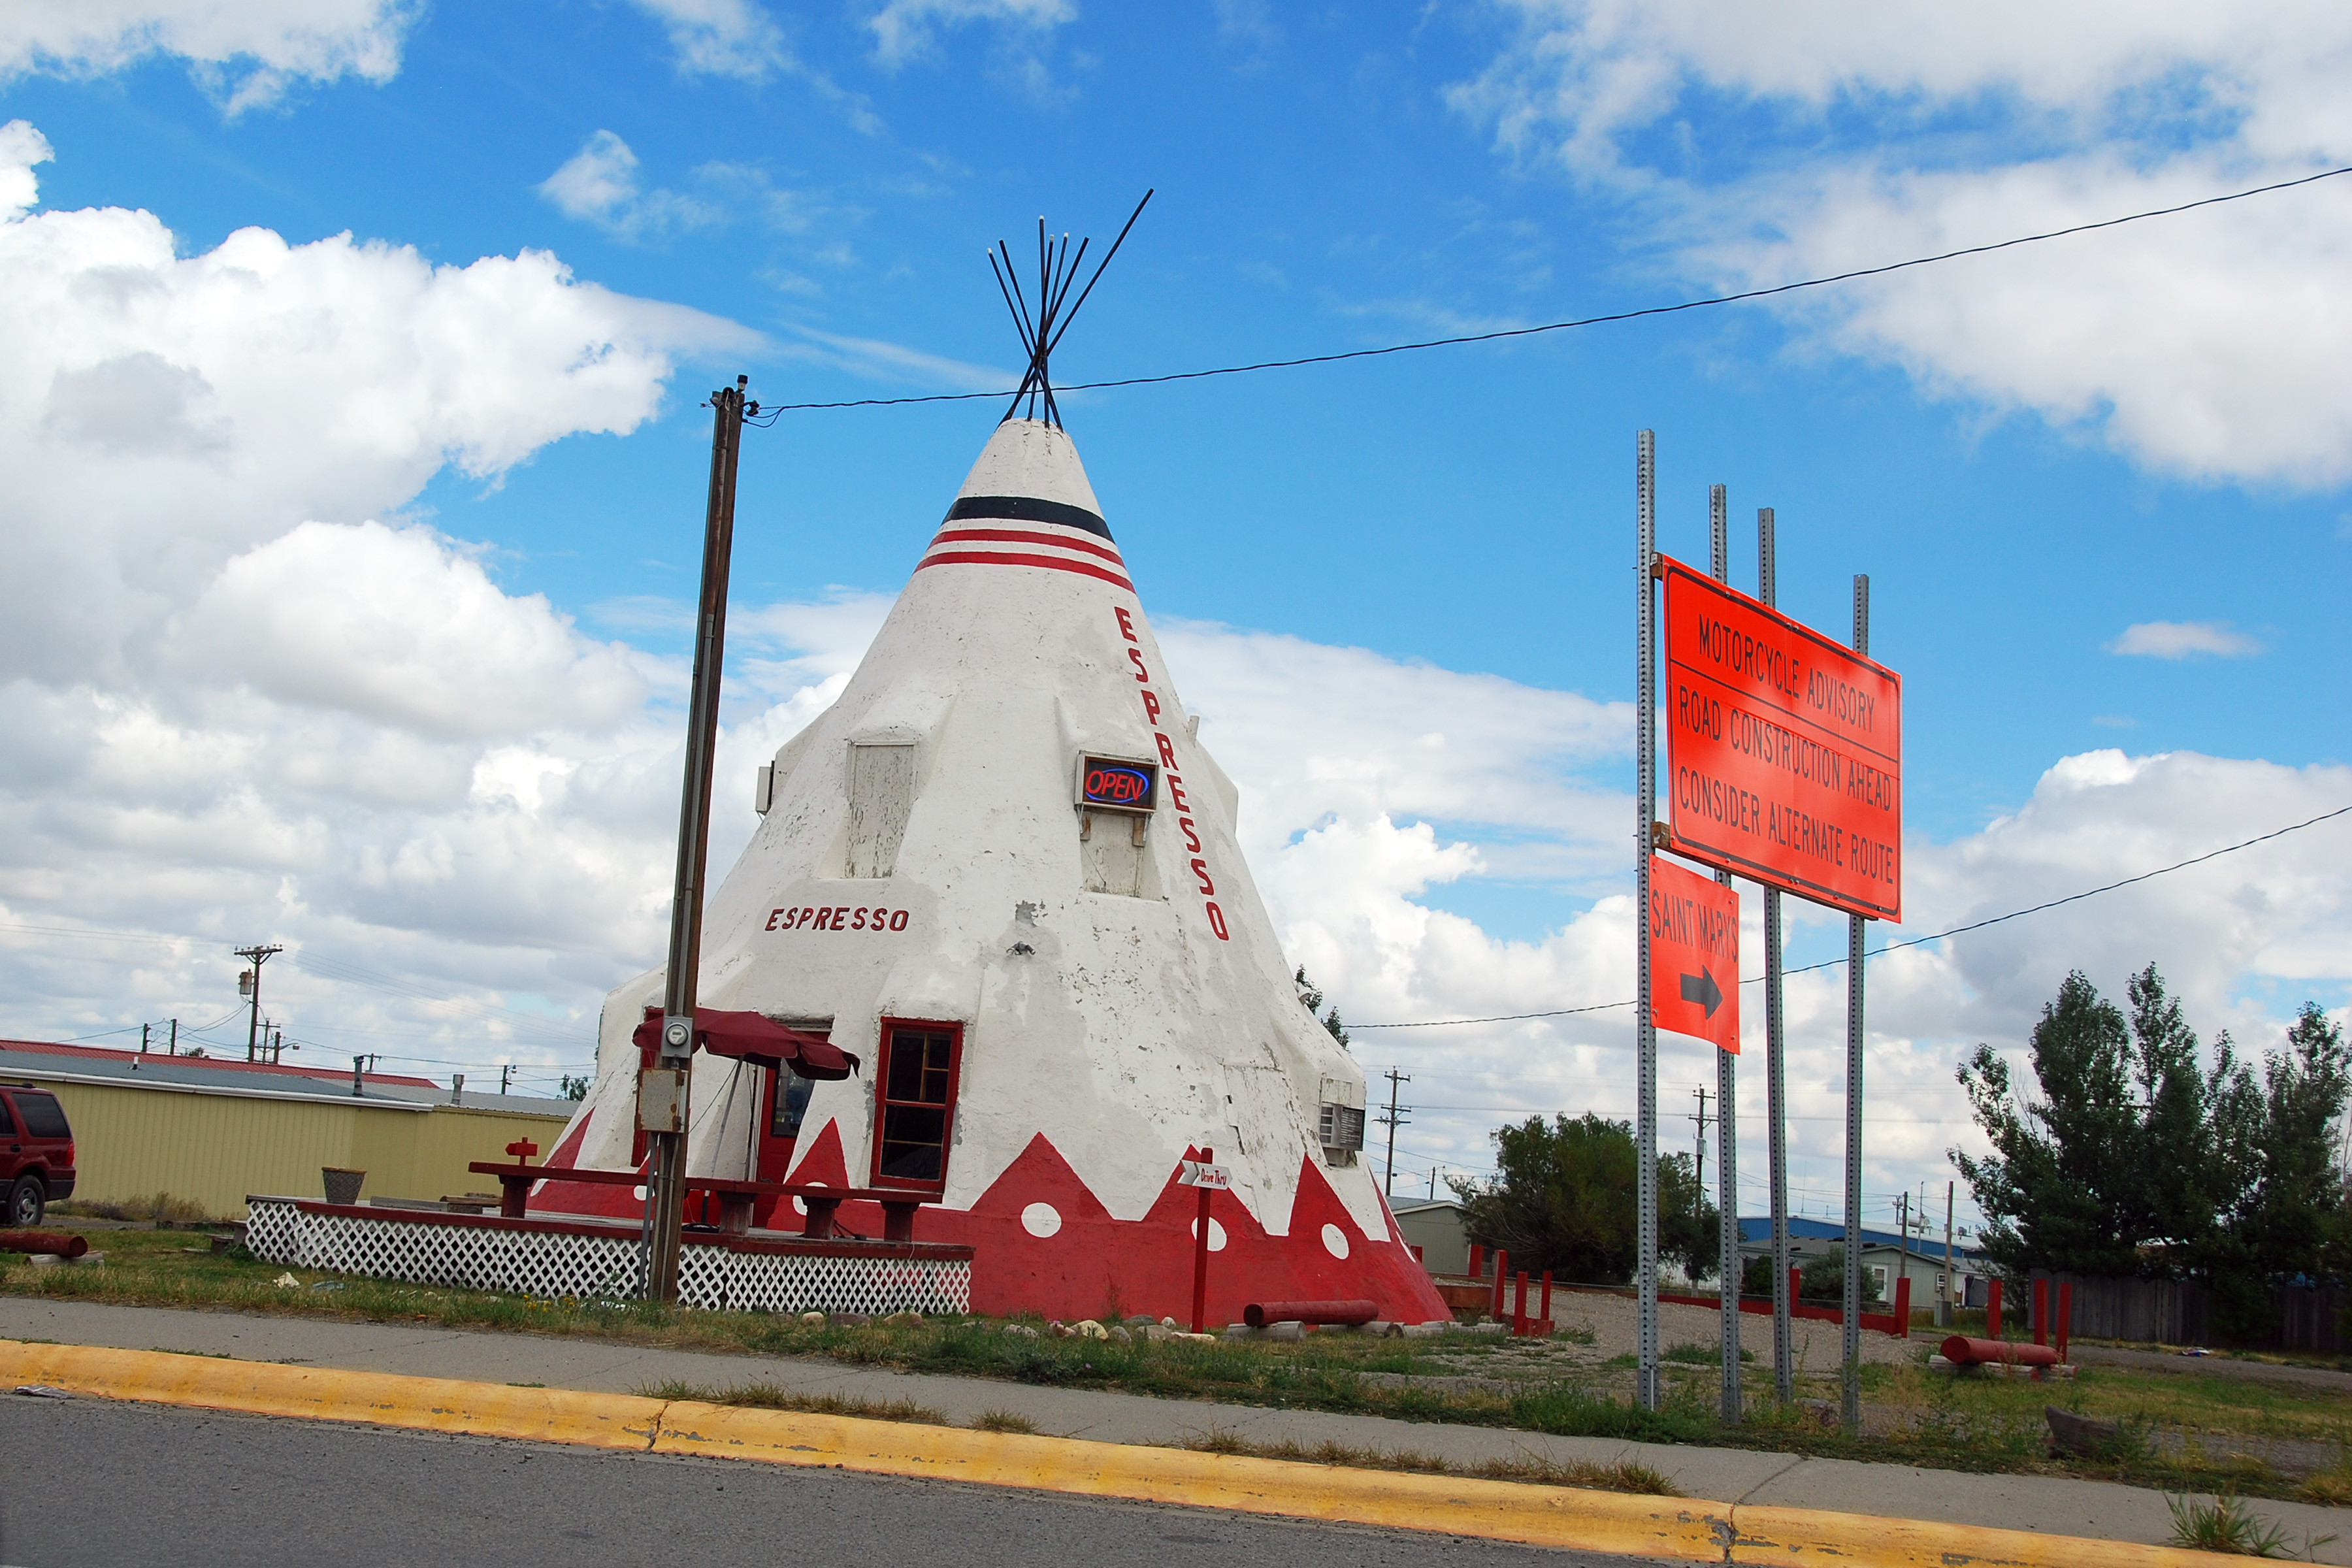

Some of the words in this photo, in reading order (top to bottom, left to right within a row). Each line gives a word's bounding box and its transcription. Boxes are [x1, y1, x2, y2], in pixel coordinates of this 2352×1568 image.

[1699, 615, 1800, 699] MOTORCYCLE
[1807, 667, 1875, 733] ADVISORY
[1086, 770, 1143, 800] OPEN
[1114, 606, 1230, 941] ESPRESSO
[1680, 685, 1721, 742] ROAD
[1730, 708, 1841, 792] CONSTRUCTION
[1848, 760, 1891, 812] AHEAD
[1679, 766, 1760, 837] CONSIDER
[1769, 803, 1842, 867] ALTERNATE
[1852, 833, 1893, 885] ROUTE
[764, 907, 909, 932] ESPRESSO
[1652, 889, 1694, 947] SAINT
[1201, 1168, 1213, 1183] Drive
